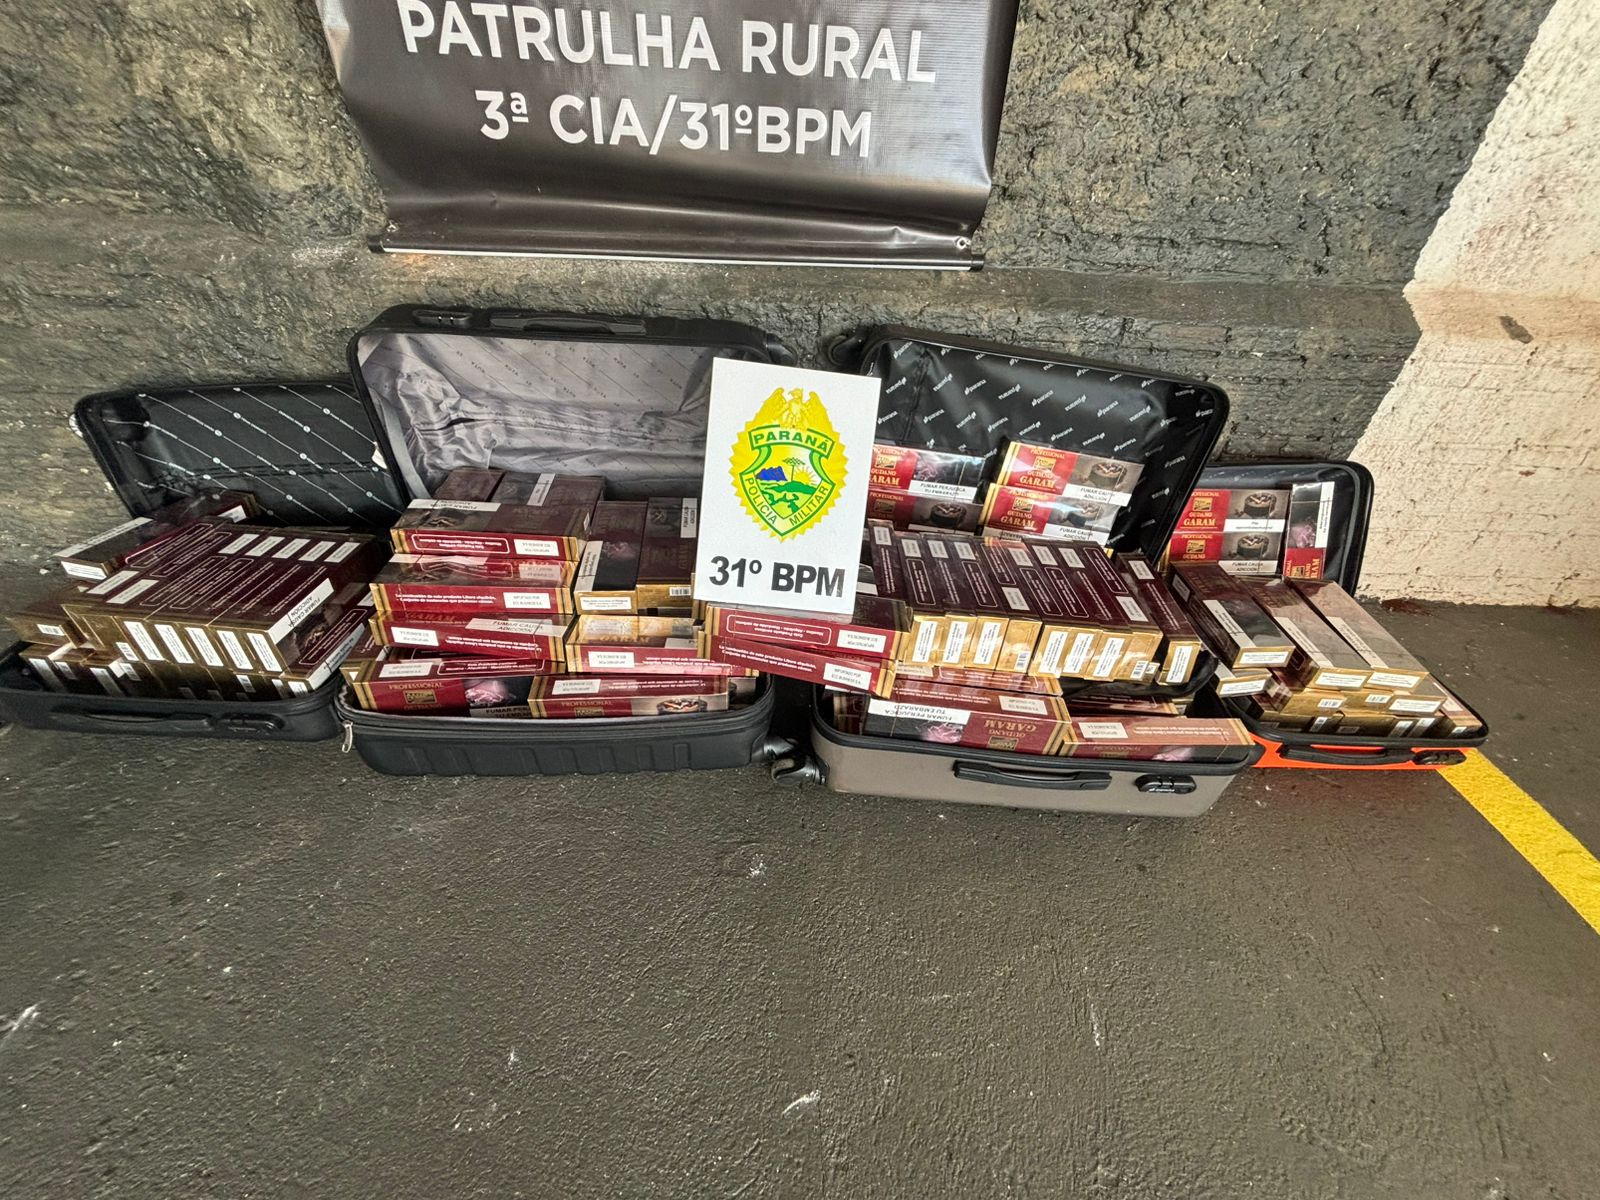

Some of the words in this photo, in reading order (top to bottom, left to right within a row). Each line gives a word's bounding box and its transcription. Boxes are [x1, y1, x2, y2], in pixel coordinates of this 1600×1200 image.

[397, 0, 720, 72] PATRULHA
[741, 20, 937, 84] RURAL
[475, 90, 530, 140] 3ª
[549, 95, 872, 158] CIA/31ºBPM
[753, 430, 831, 452] PARANÁ
[1030, 448, 1065, 459] PROFESSIONAL
[1020, 476, 1056, 489] GARAM
[1080, 487, 1097, 495] FUMAR
[789, 484, 829, 527] MILITAR
[1007, 510, 1032, 519] GUDANG
[1001, 515, 1035, 528] GARAM
[1183, 518, 1216, 527] GARAM
[709, 555, 763, 588] 31º
[770, 562, 846, 598] BPM
[304, 597, 321, 614] FUMAR
[388, 681, 444, 691] PROFESSIONAL
[984, 719, 1038, 732] GARAM
[988, 729, 1027, 738] GUDANG
